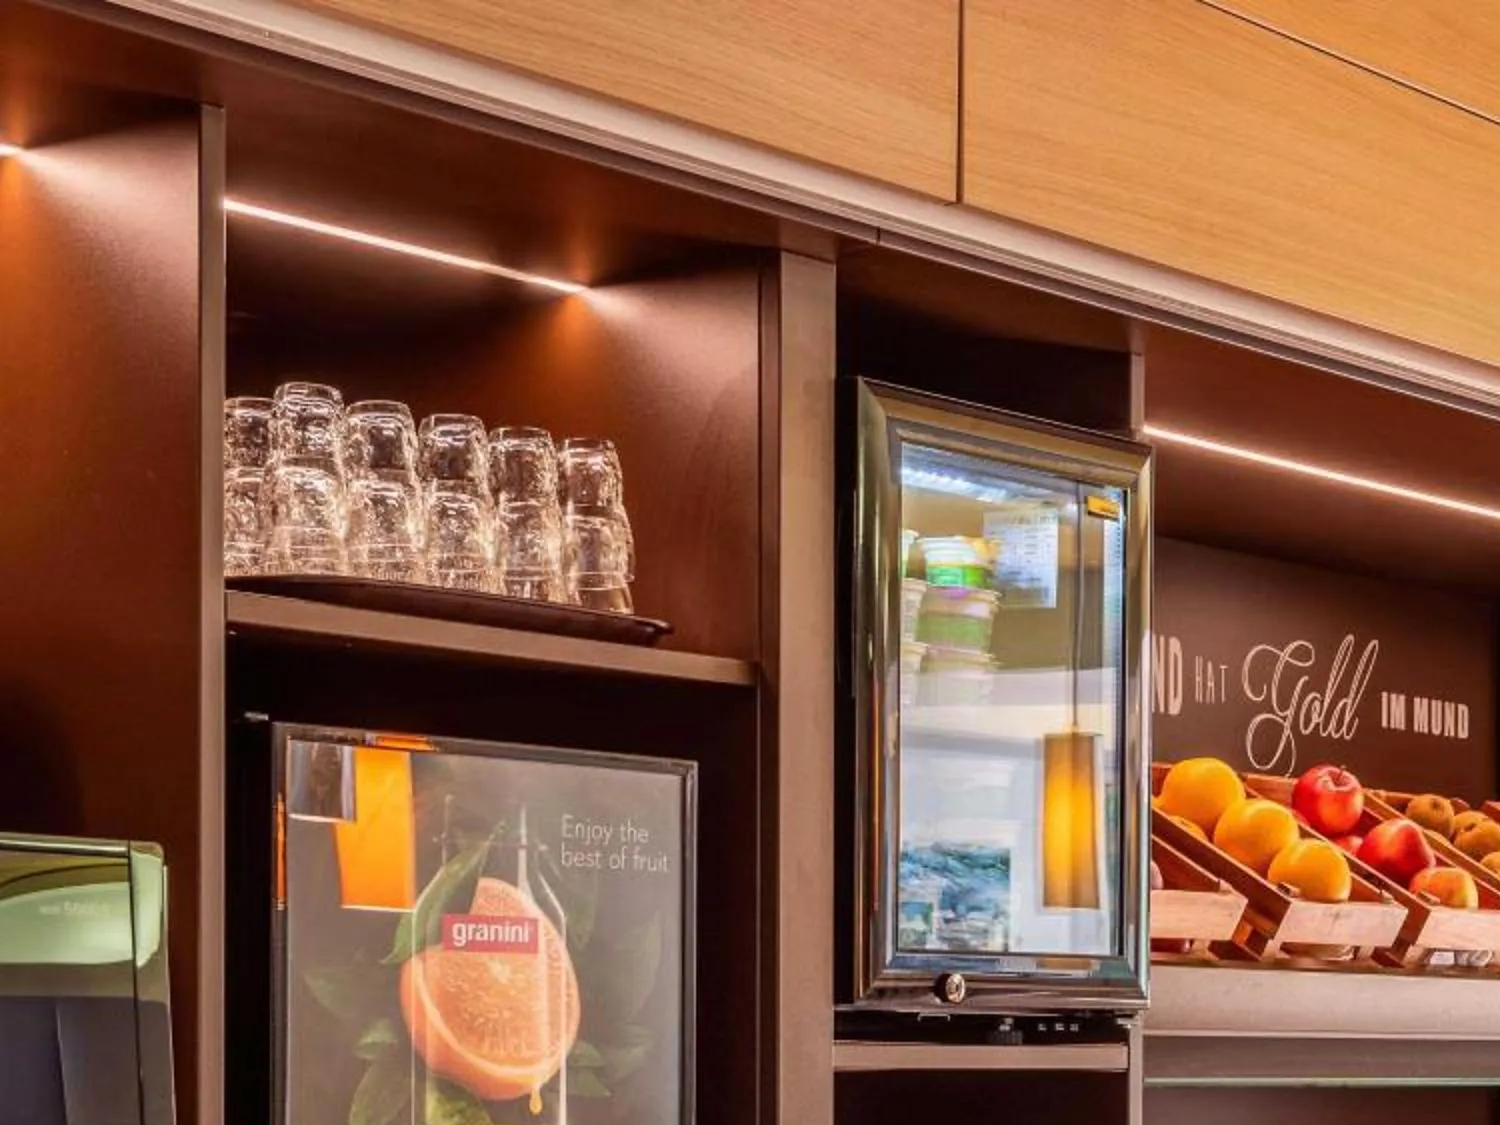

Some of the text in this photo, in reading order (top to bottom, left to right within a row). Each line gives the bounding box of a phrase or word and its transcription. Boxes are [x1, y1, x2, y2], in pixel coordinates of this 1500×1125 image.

[1195, 655, 1228, 704] HAT
[1241, 633, 1380, 777] Gold
[1381, 691, 1406, 731] IM
[1413, 695, 1469, 739] MUND
[561, 814, 649, 844] Enjoy the
[561, 845, 671, 872] best of fruit
[451, 920, 530, 947] granini
